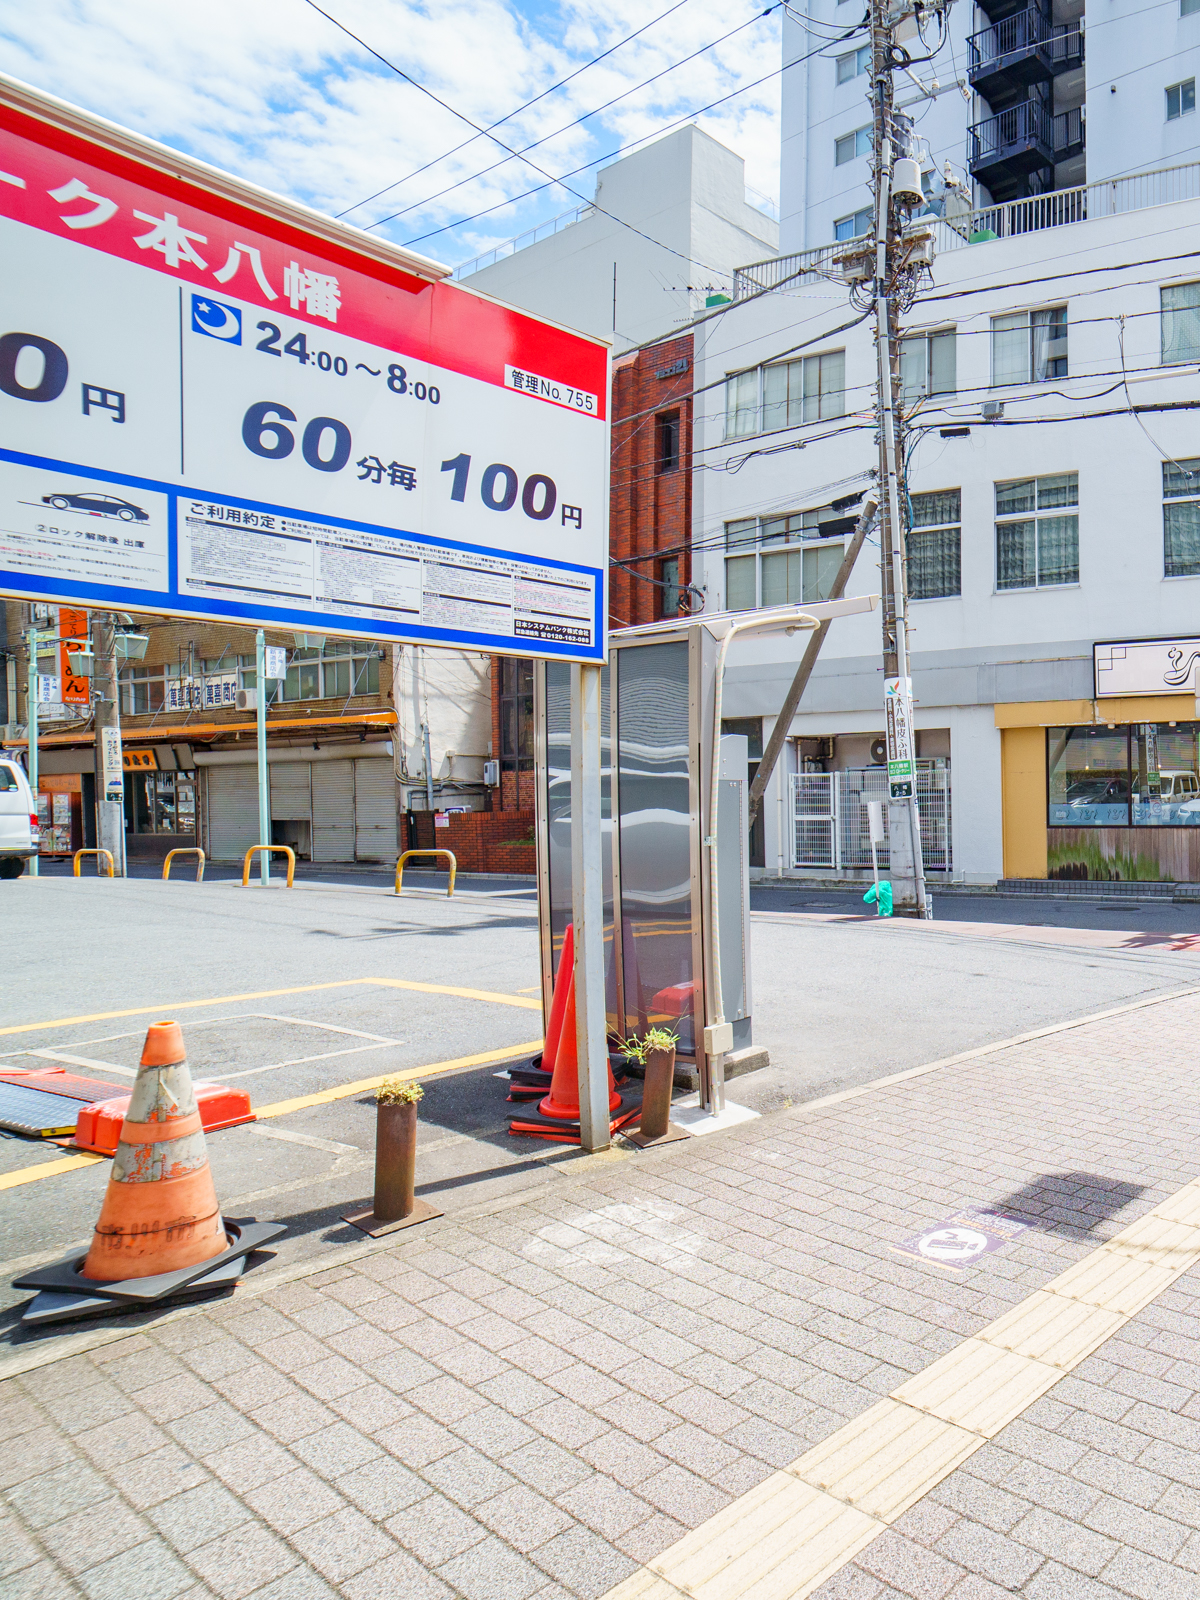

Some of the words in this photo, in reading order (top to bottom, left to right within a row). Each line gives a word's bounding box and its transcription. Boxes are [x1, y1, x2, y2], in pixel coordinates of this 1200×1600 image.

[190, 502, 276, 530] ご利用約定
[516, 620, 589, 637] 日本システムバンク株式会社
[895, 697, 908, 760] 本八幡皮ふ科
